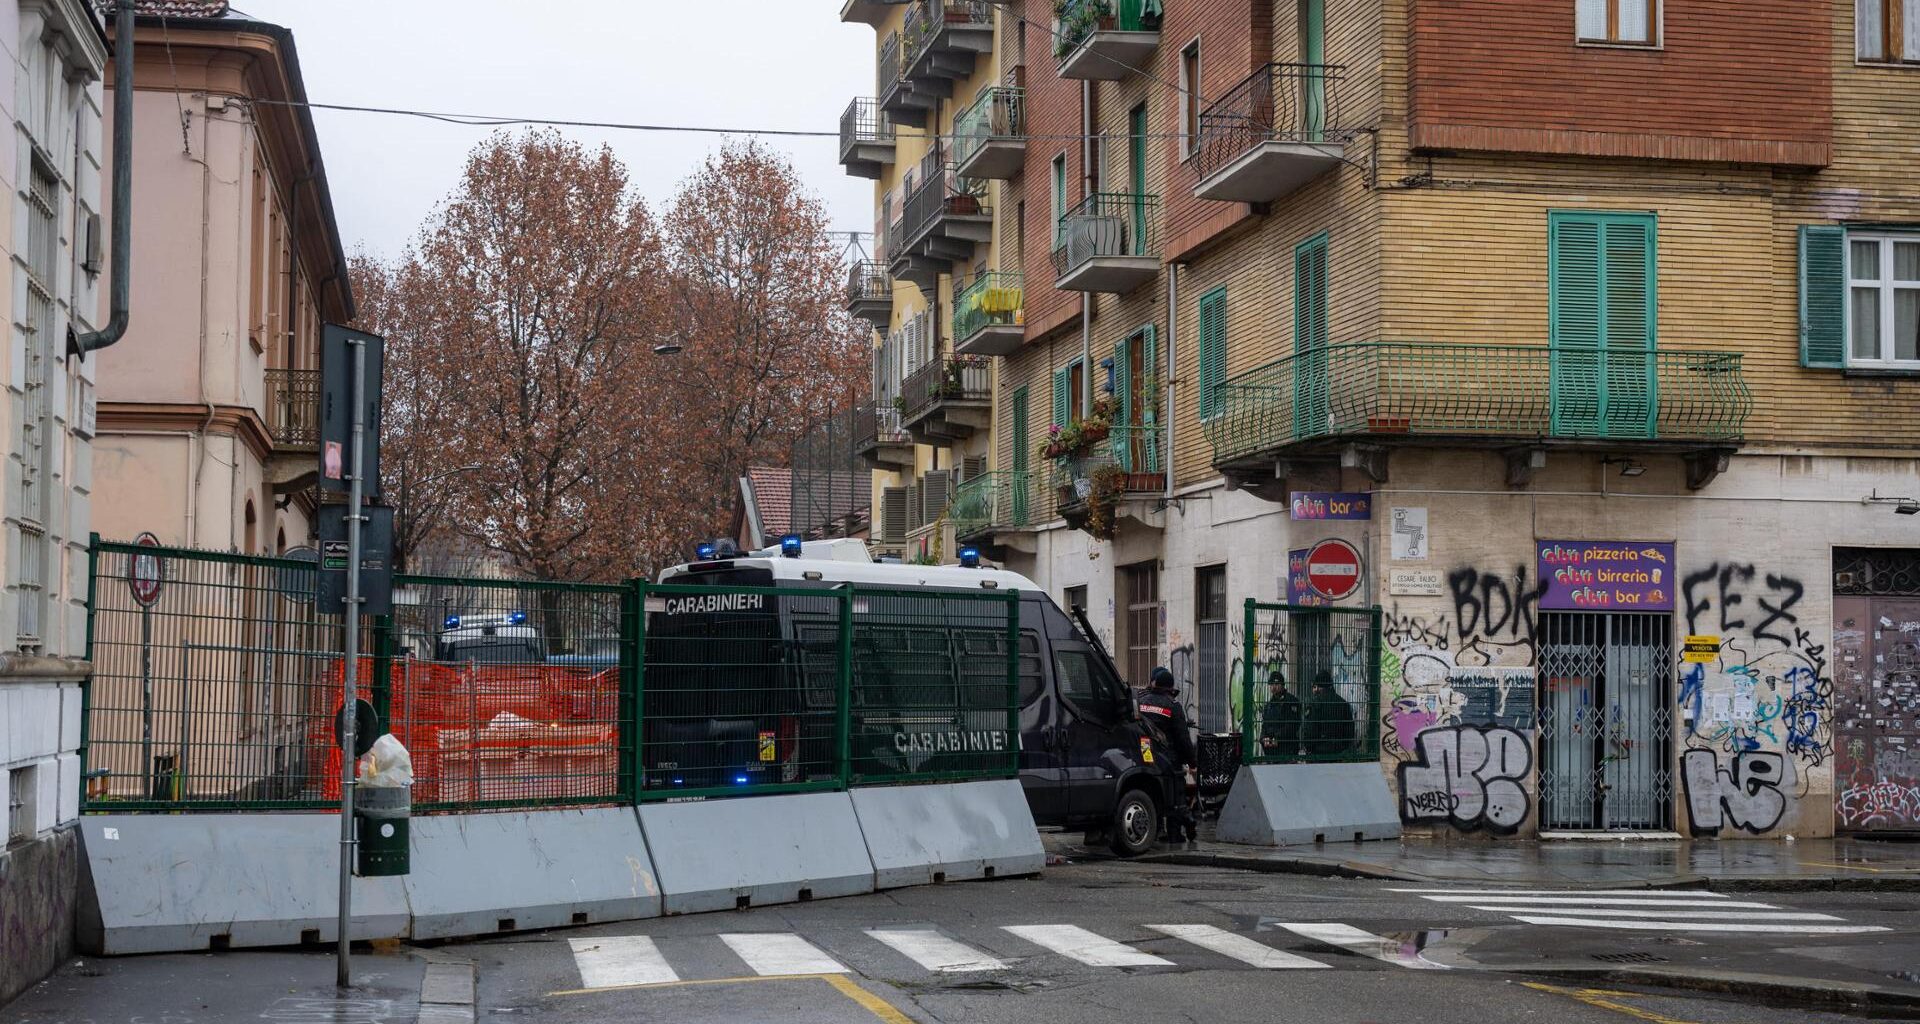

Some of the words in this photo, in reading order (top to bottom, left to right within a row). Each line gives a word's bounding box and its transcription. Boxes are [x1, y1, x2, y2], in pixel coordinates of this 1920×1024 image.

[1329, 497, 1351, 515] bar
[1583, 546, 1638, 563] pizzeria
[1597, 568, 1649, 583] birreria
[665, 593, 763, 616] CARABINIERI
[1448, 563, 1550, 645] BDK
[1615, 589, 1641, 604] bar
[1682, 562, 1804, 648] FEZ
[893, 730, 1024, 752] CARABINIEI
[657, 762, 678, 770] IVECO
